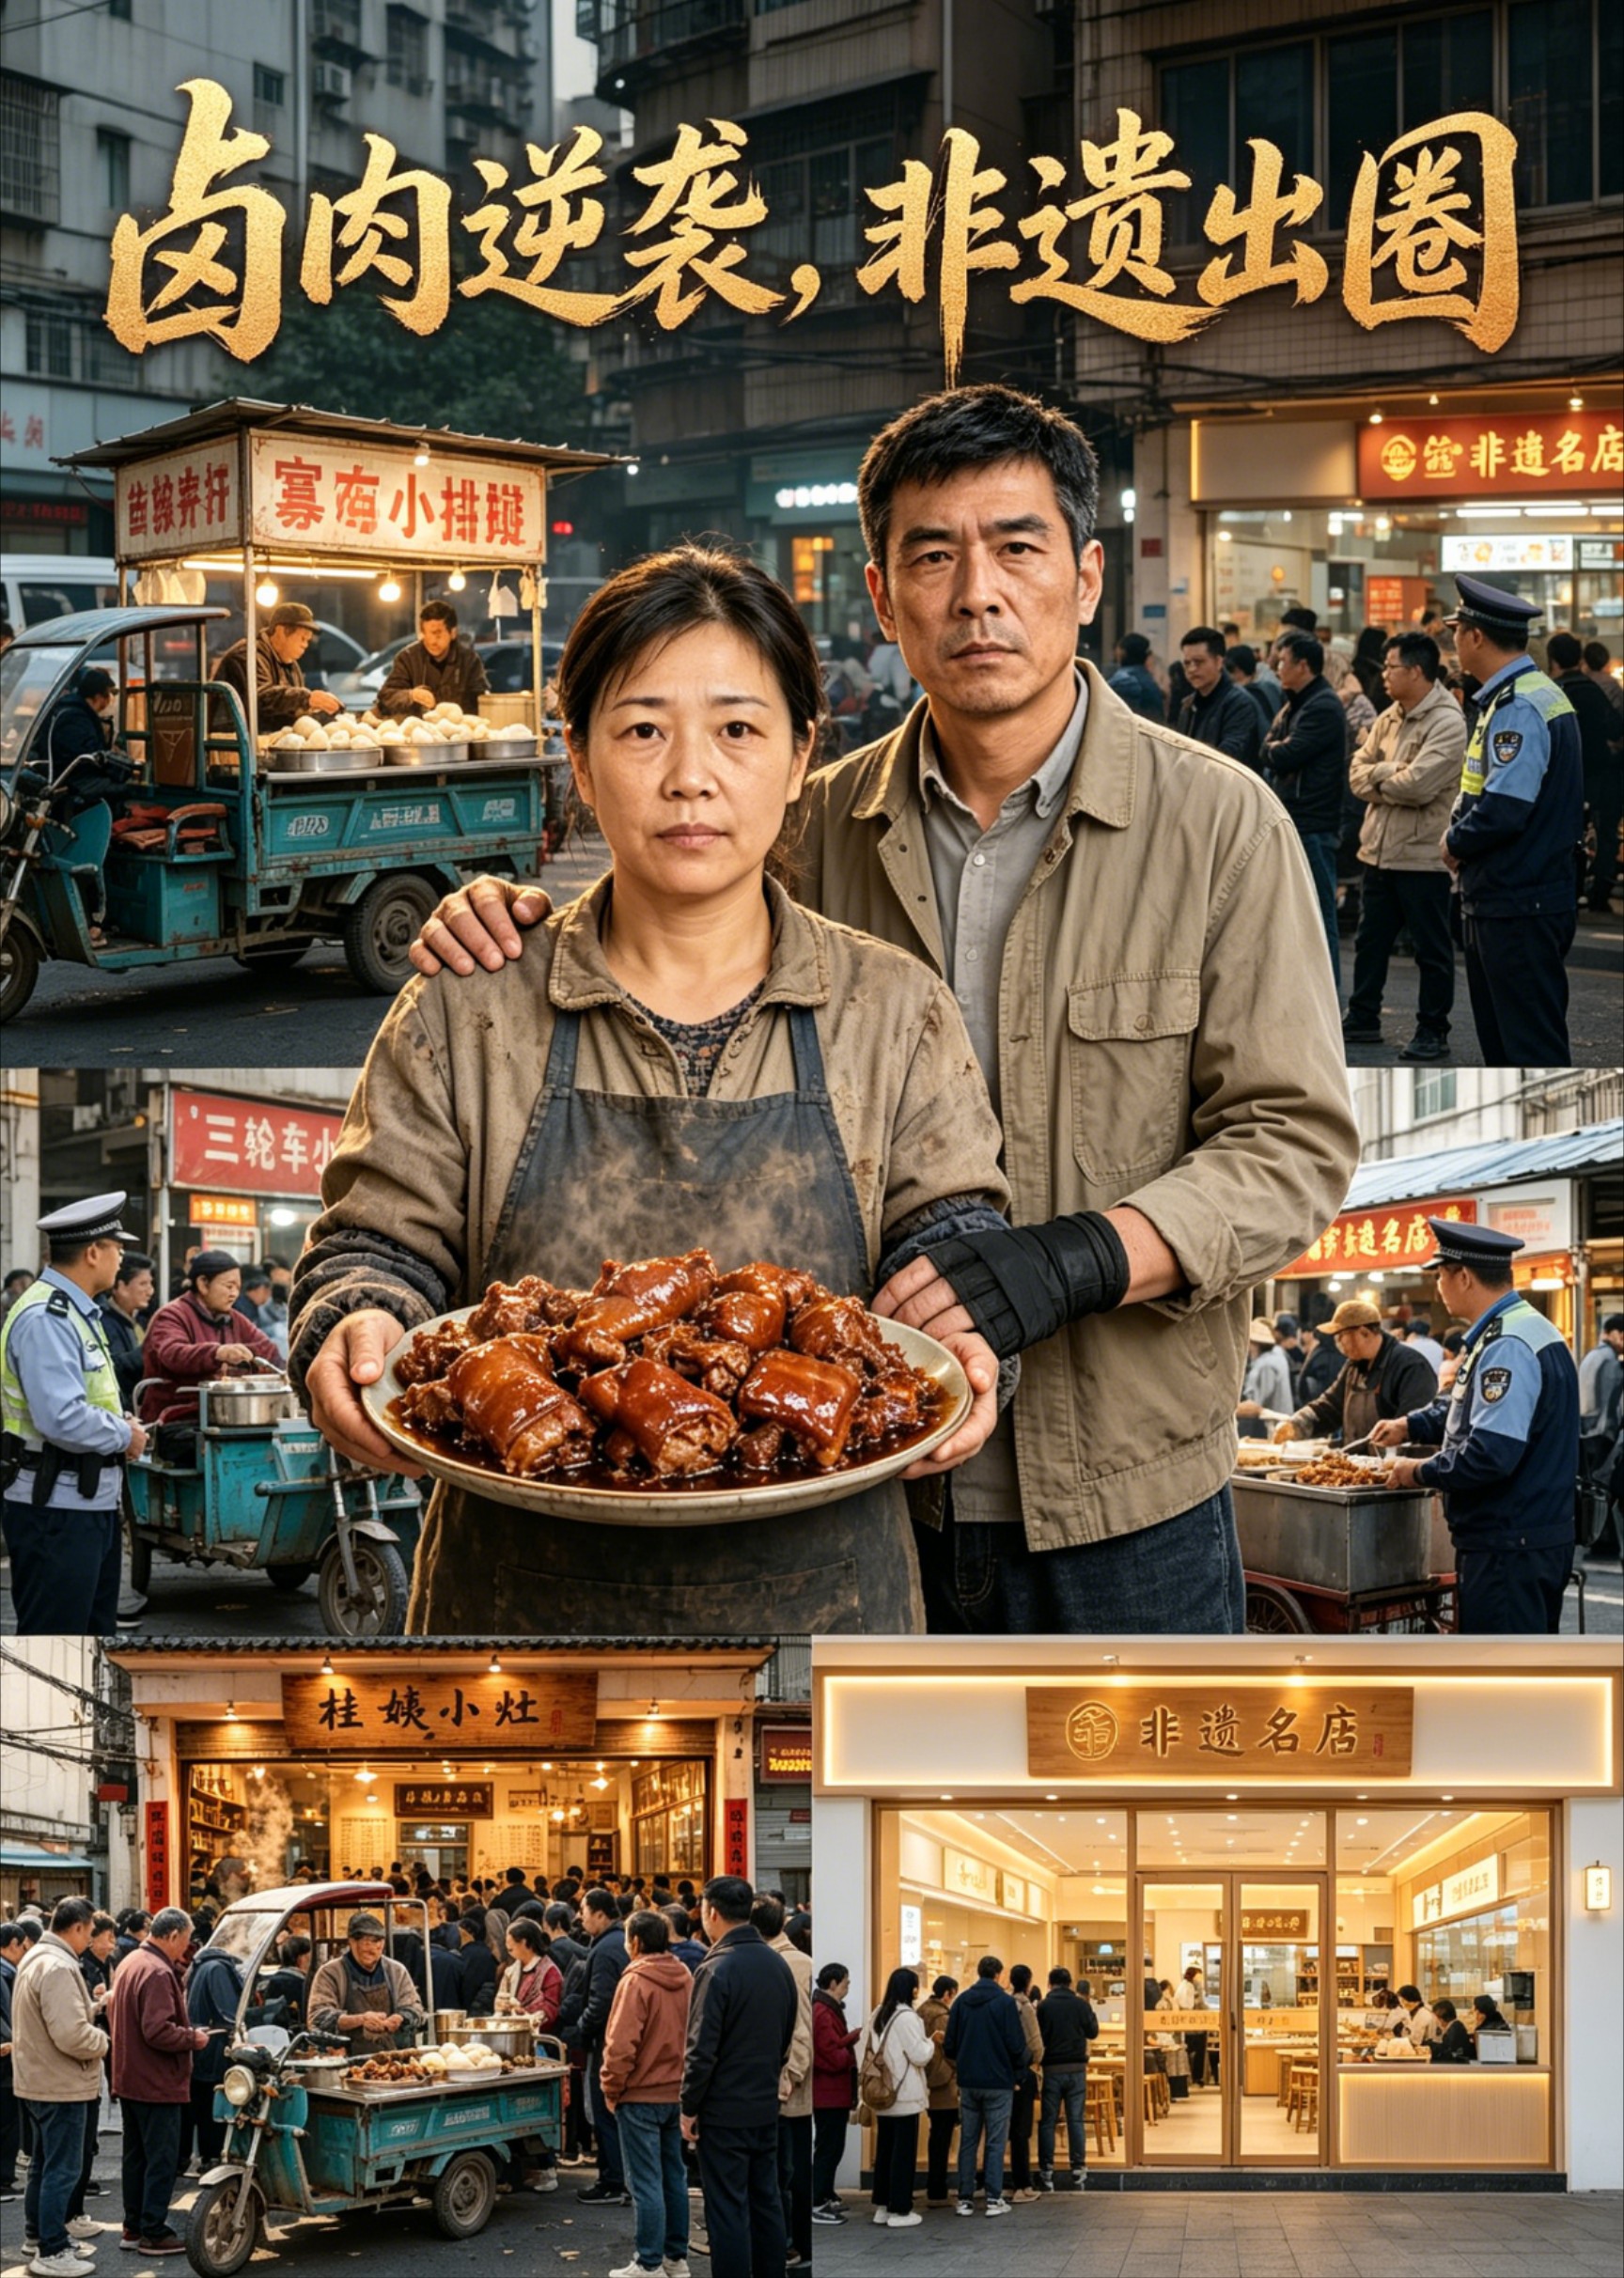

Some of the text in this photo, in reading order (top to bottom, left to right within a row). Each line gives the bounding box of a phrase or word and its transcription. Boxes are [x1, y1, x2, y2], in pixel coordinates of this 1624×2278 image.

[204, 1114, 336, 1175] 三轮车小
[318, 1685, 540, 1734] 桂姨小灶
[1139, 1703, 1359, 1758] 非遗名店
